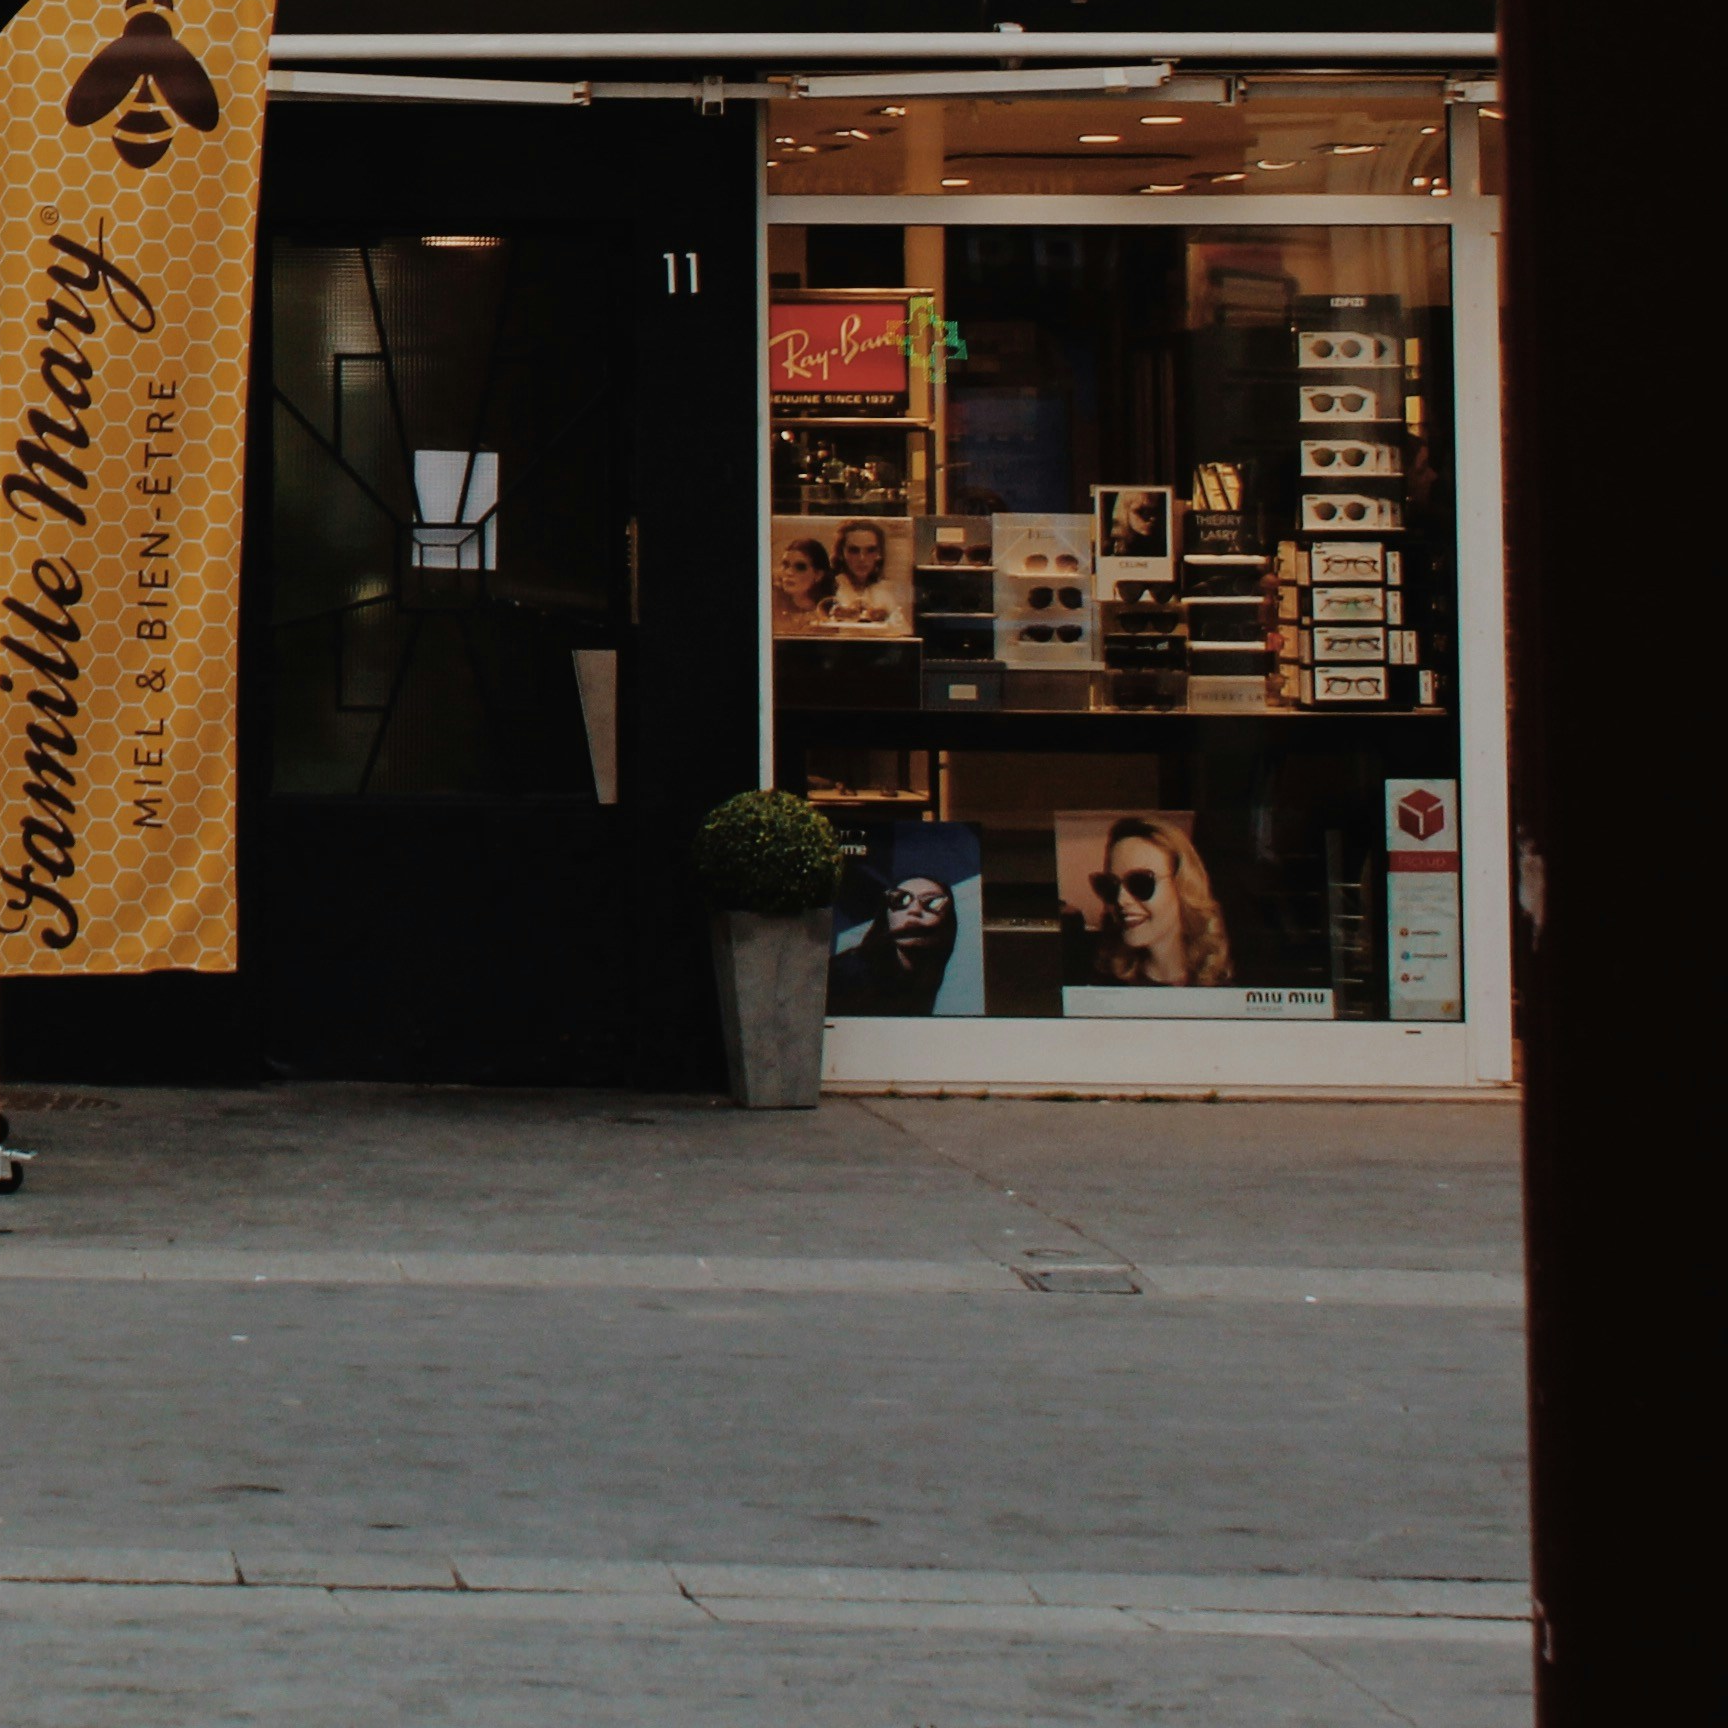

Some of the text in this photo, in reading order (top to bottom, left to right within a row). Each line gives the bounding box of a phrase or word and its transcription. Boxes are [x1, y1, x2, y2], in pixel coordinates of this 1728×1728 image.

[663, 252, 700, 294] 11
[770, 394, 895, 404] ENUINE SINCE 1937
[133, 379, 178, 828] MIEL & BIEN-ÊTRE
